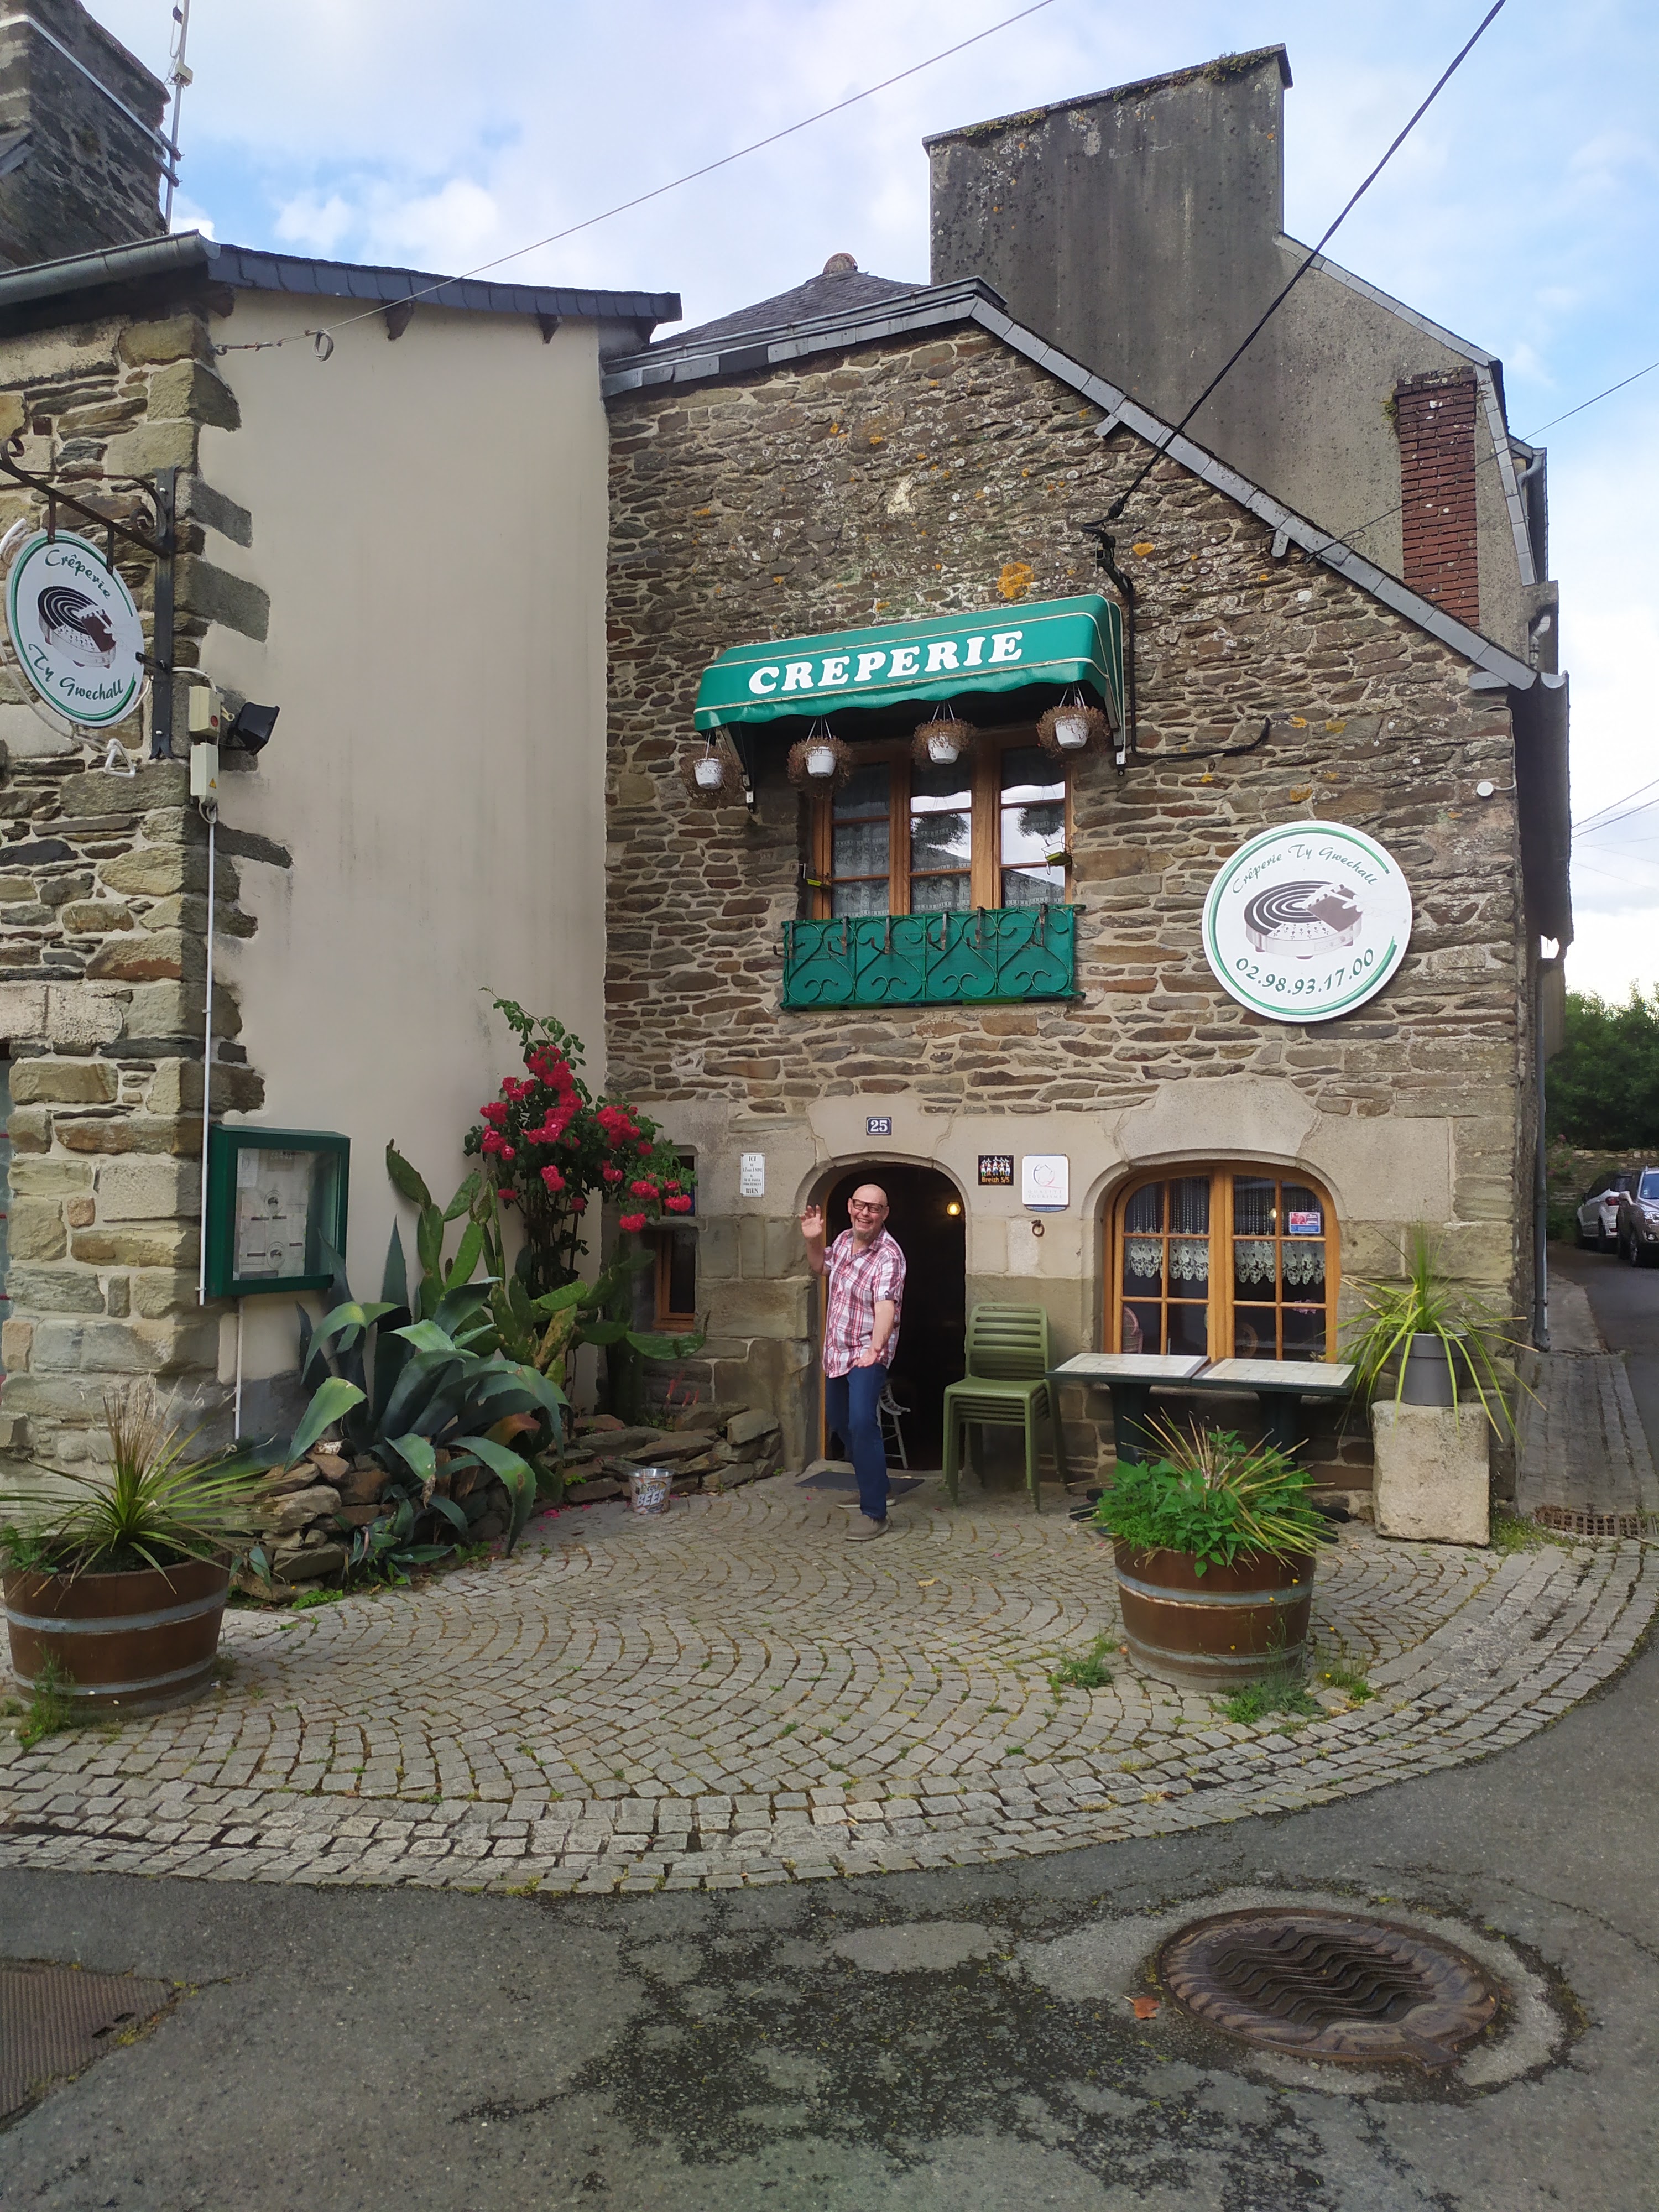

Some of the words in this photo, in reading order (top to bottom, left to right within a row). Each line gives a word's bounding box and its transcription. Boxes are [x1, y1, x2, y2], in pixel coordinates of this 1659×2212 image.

[45, 549, 111, 599] Crêperie
[28, 644, 54, 682] Ty
[59, 677, 123, 700] Gwechall
[748, 630, 1023, 694] CREPERIE
[1232, 853, 1282, 894] Crêperie
[1288, 844, 1311, 860] Ty
[1318, 847, 1379, 885] Gwechall
[1235, 948, 1374, 995] 02.98.93.17.00
[870, 1120, 888, 1132] 25
[637, 1489, 666, 1507] BEER
